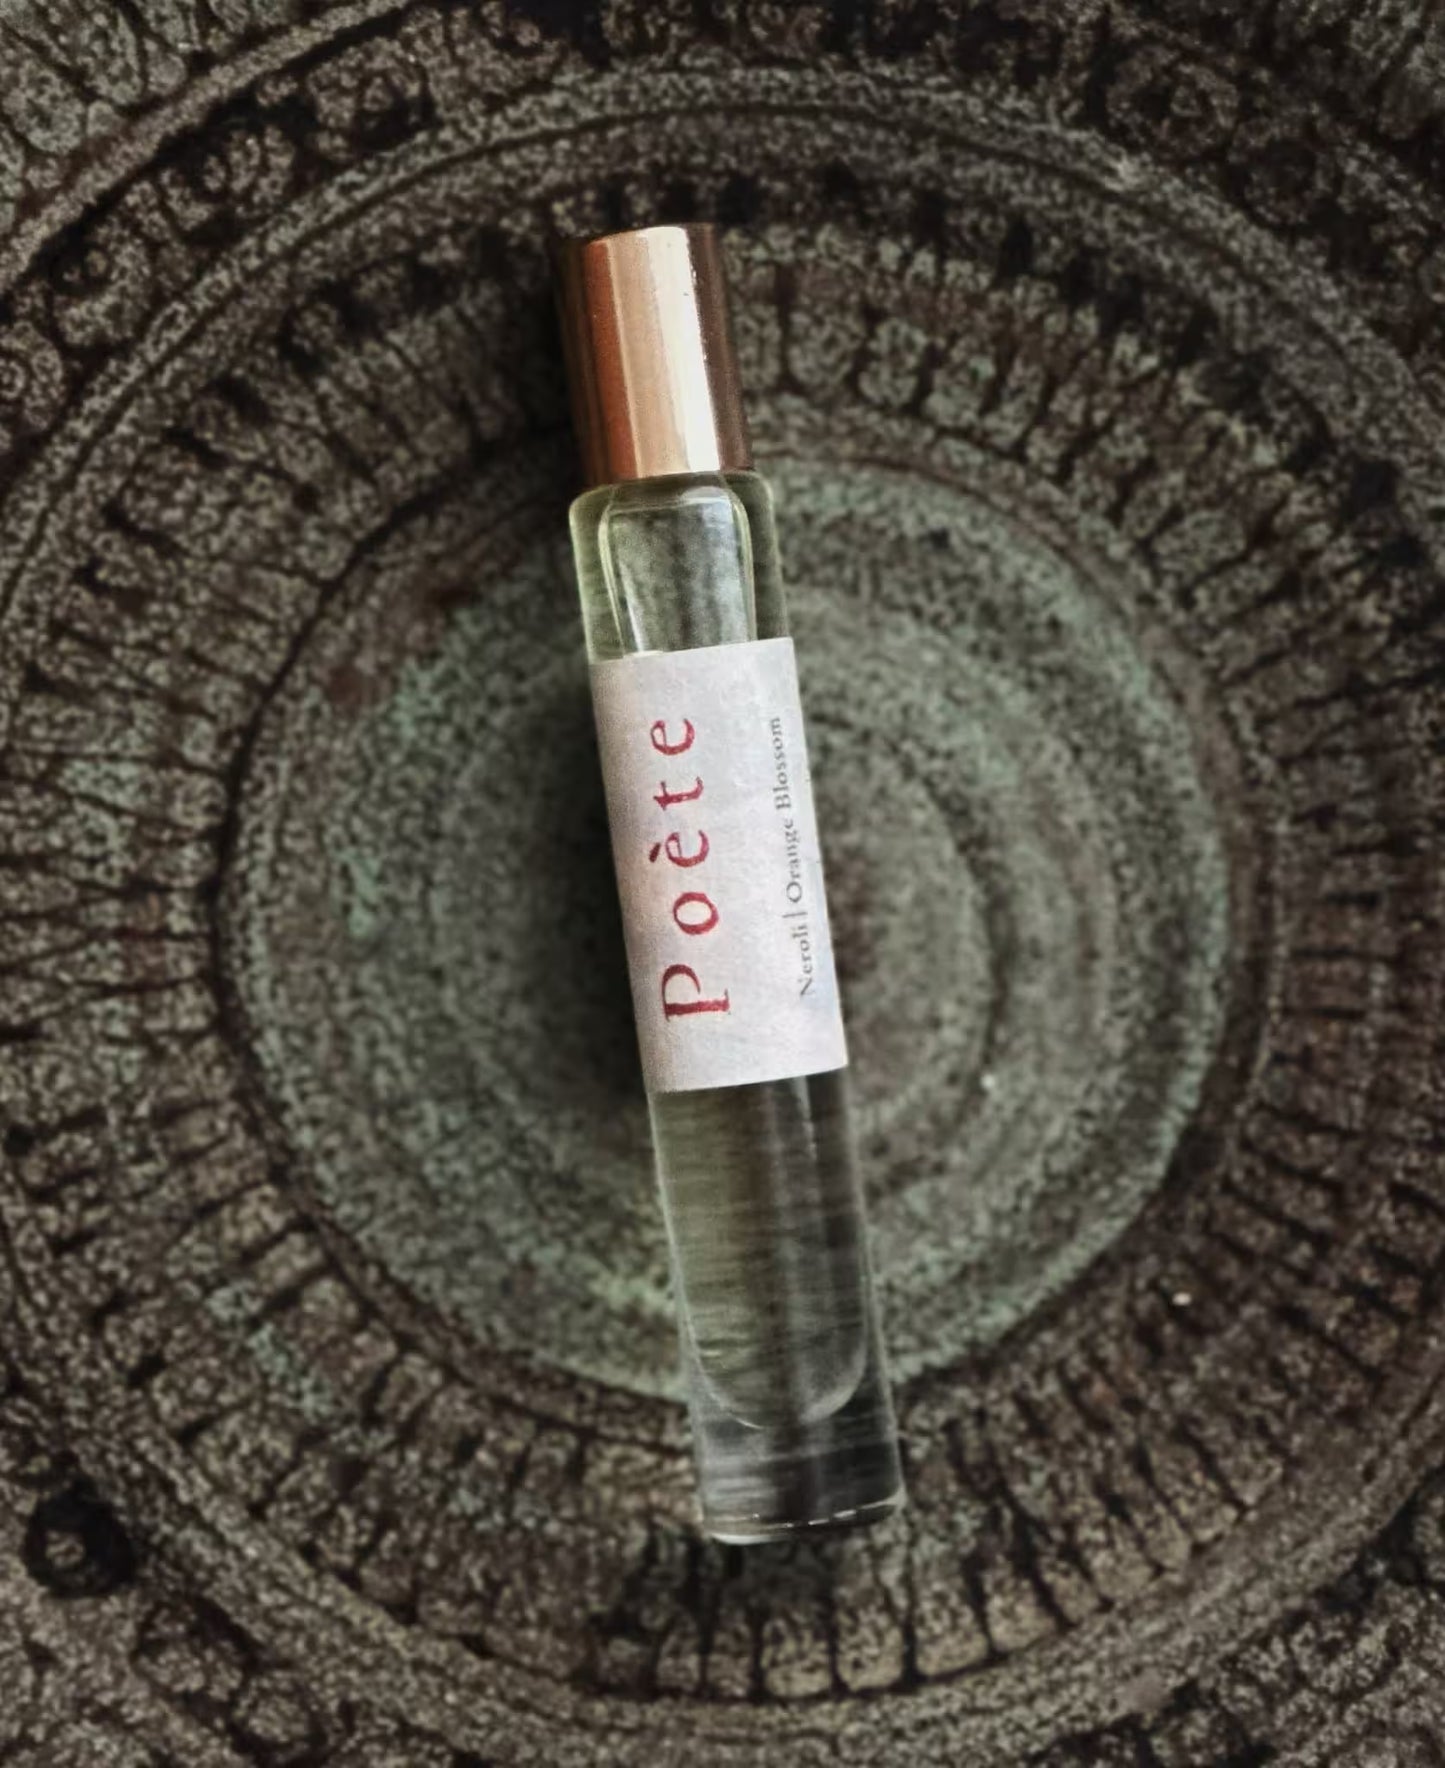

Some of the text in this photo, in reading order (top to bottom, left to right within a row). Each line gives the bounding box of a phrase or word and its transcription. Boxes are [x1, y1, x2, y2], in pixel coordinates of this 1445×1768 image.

[649, 718, 731, 1022] Poète
[770, 716, 814, 997] Neroli Orange Blossom
